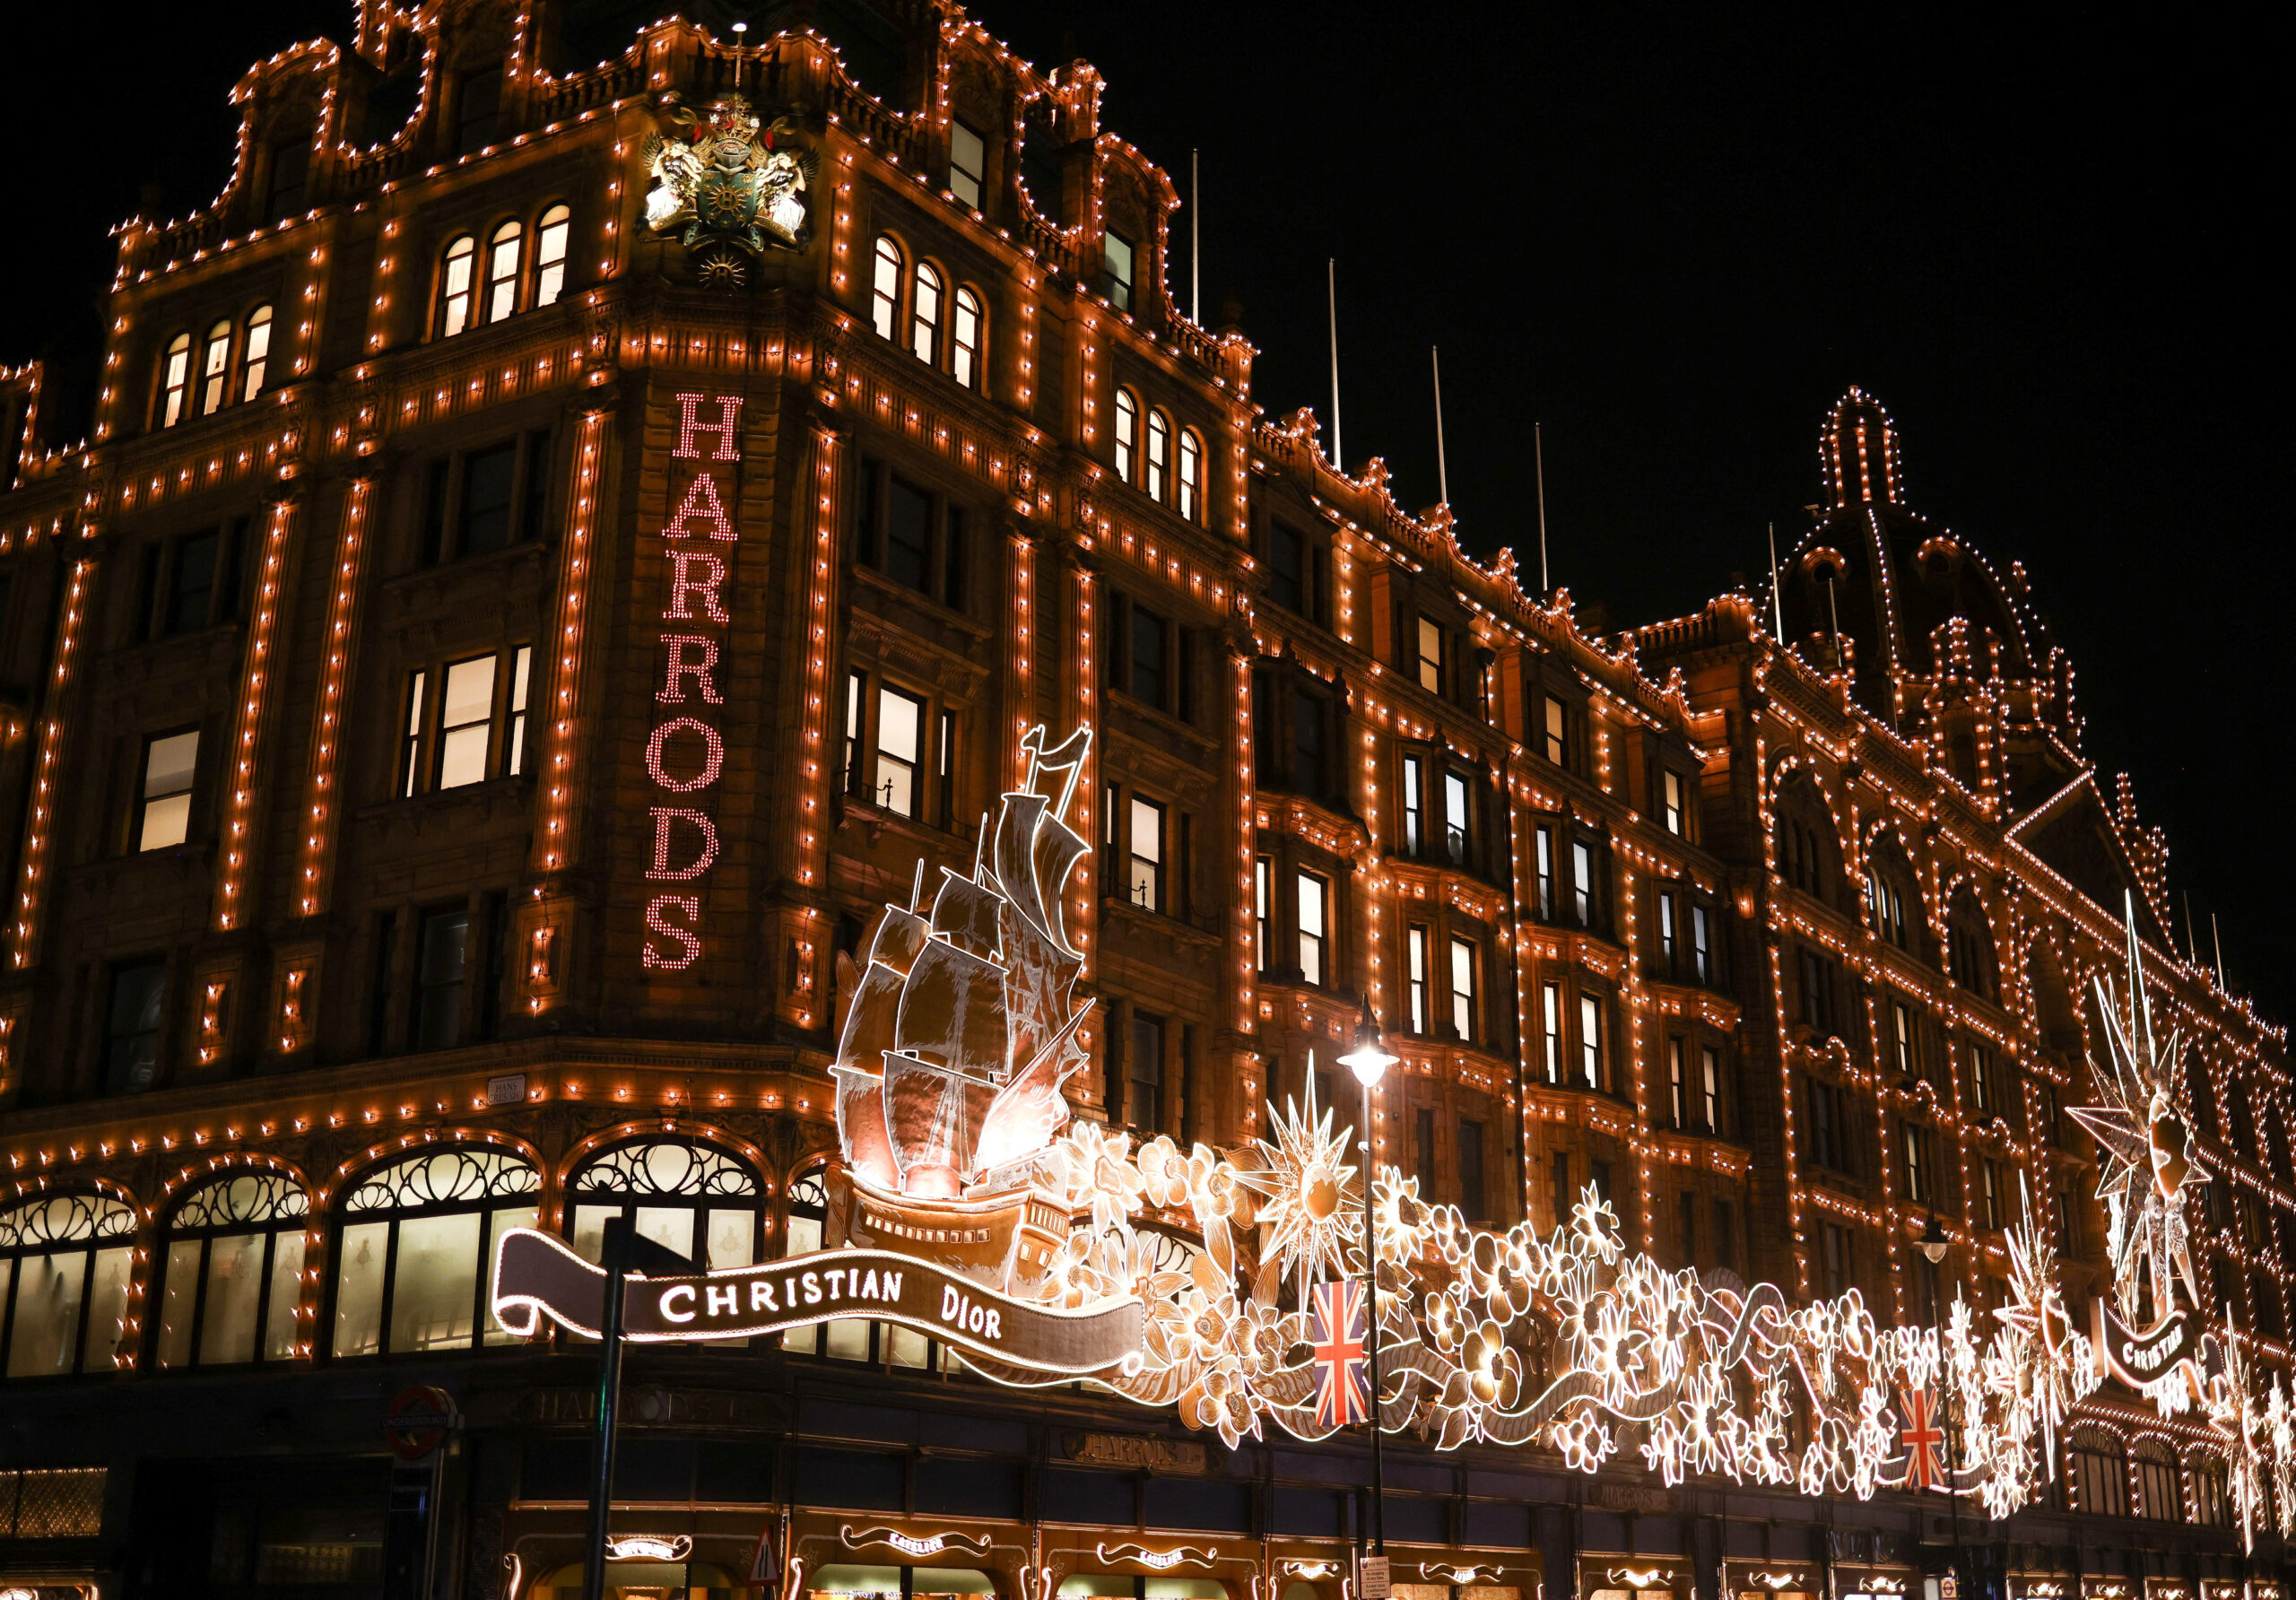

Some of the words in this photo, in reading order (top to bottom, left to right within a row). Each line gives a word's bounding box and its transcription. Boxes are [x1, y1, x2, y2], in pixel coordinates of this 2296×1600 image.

[643, 393, 744, 970] HARRODS
[495, 1083, 517, 1092] HANS
[659, 1268, 902, 1323] CHRISTIAN
[941, 1284, 1002, 1339] DIOR
[2122, 1324, 2183, 1371] CHRISTIAN
[1088, 1434, 1178, 1466] HARRODS
